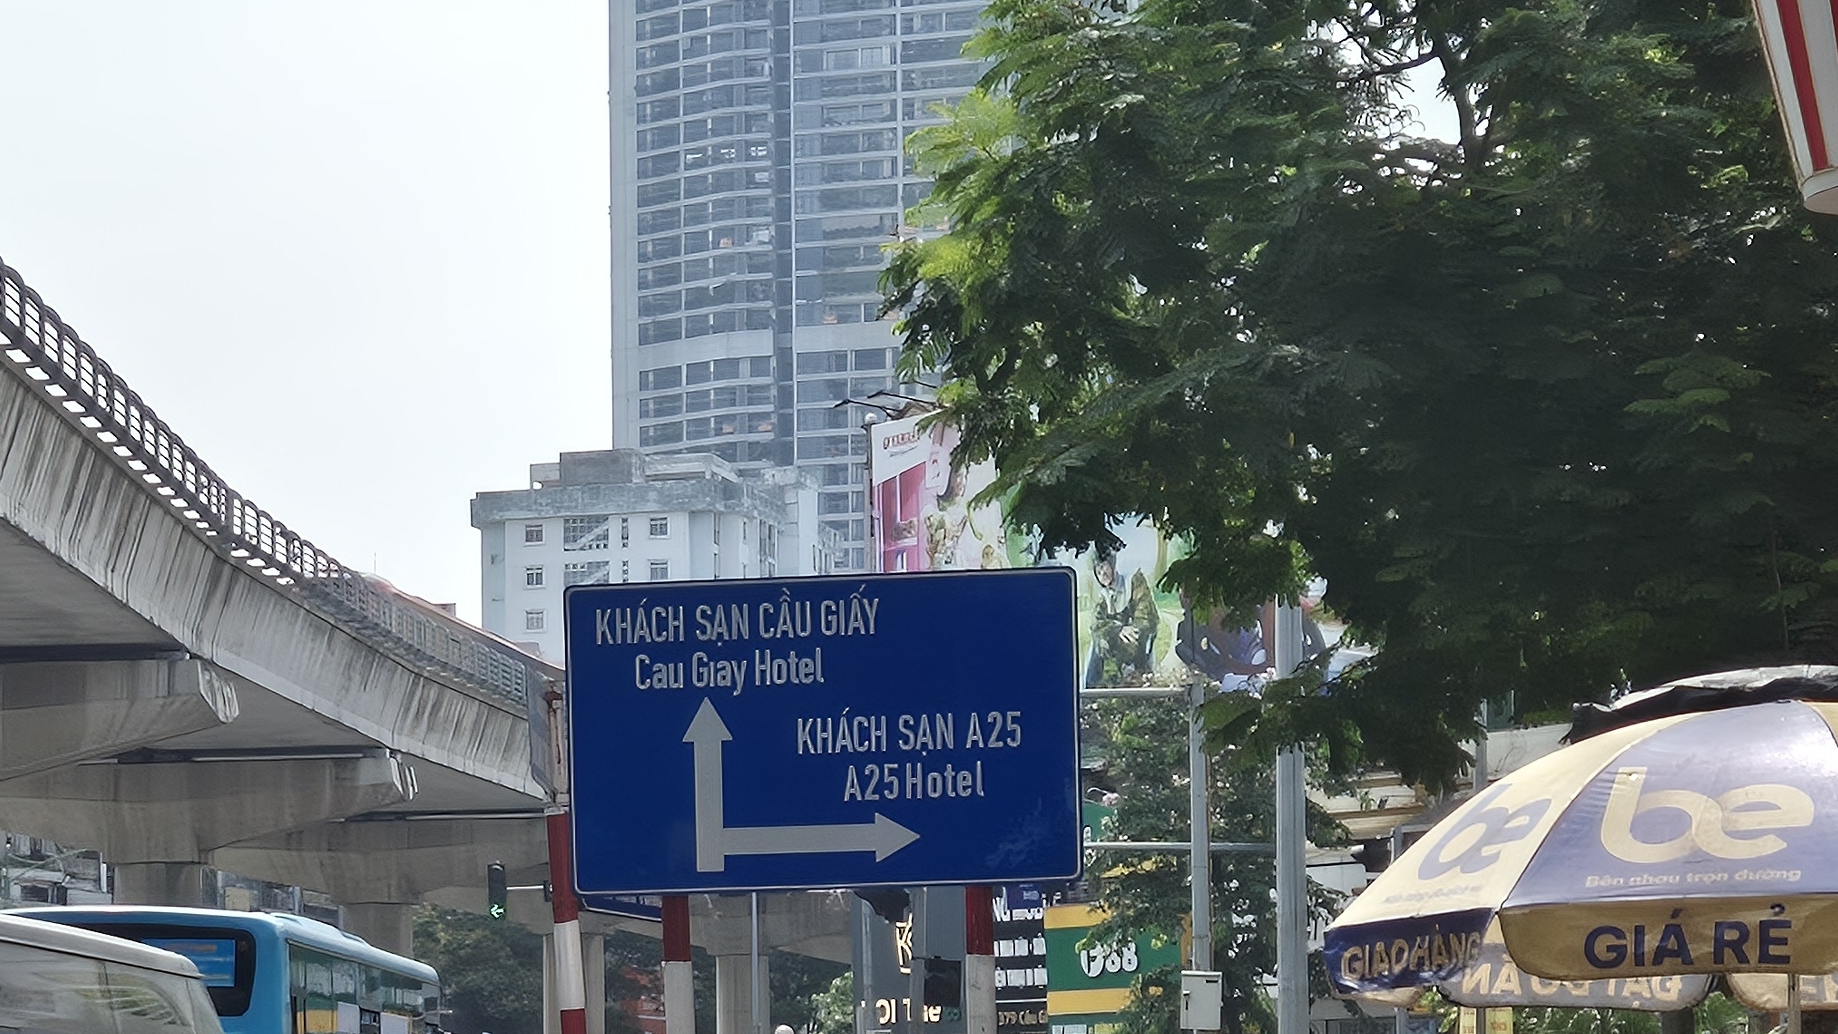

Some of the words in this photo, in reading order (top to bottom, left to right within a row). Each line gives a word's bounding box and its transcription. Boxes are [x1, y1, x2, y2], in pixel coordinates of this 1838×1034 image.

[595, 598, 685, 645] KHÁCH
[695, 604, 749, 647] SẠN
[759, 588, 811, 641] CẦU
[820, 584, 880, 637] GIẤY
[635, 654, 684, 690] Cau
[691, 650, 747, 696] Giay
[754, 647, 824, 686] Hotel
[797, 707, 887, 755] KHÁCH
[899, 713, 954, 756] SẠN
[965, 711, 1022, 749] A25
[844, 764, 899, 802] A25
[905, 760, 985, 799] Hotel
[1417, 783, 1553, 881] be
[1600, 766, 1815, 865] be
[1583, 908, 1694, 970] GIÁ
[1713, 902, 1793, 966] RẺ
